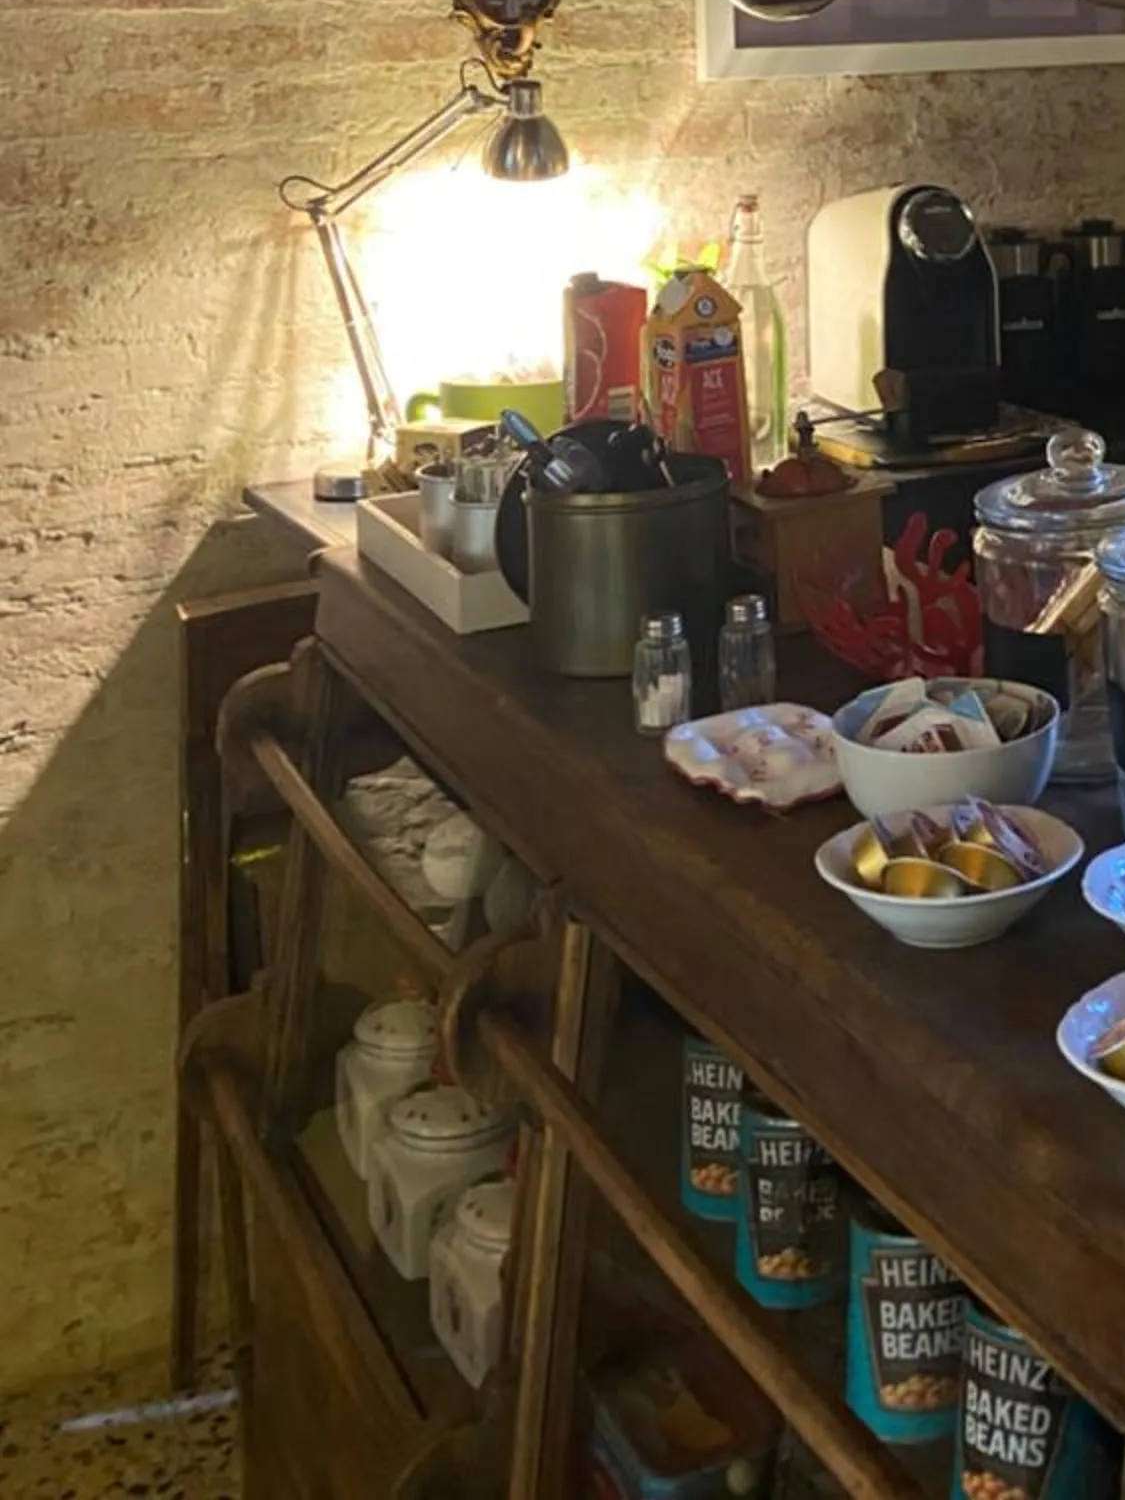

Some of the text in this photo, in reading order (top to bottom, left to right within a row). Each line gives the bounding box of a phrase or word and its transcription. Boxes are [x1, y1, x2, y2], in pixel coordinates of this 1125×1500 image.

[692, 1061, 744, 1091] HEIN
[690, 1096, 742, 1126] BAKE
[690, 1123, 740, 1151] BEAN
[968, 1336, 1051, 1392] HEINZ
[965, 1378, 1052, 1436] BAKED
[964, 1413, 1048, 1467] BEANS
